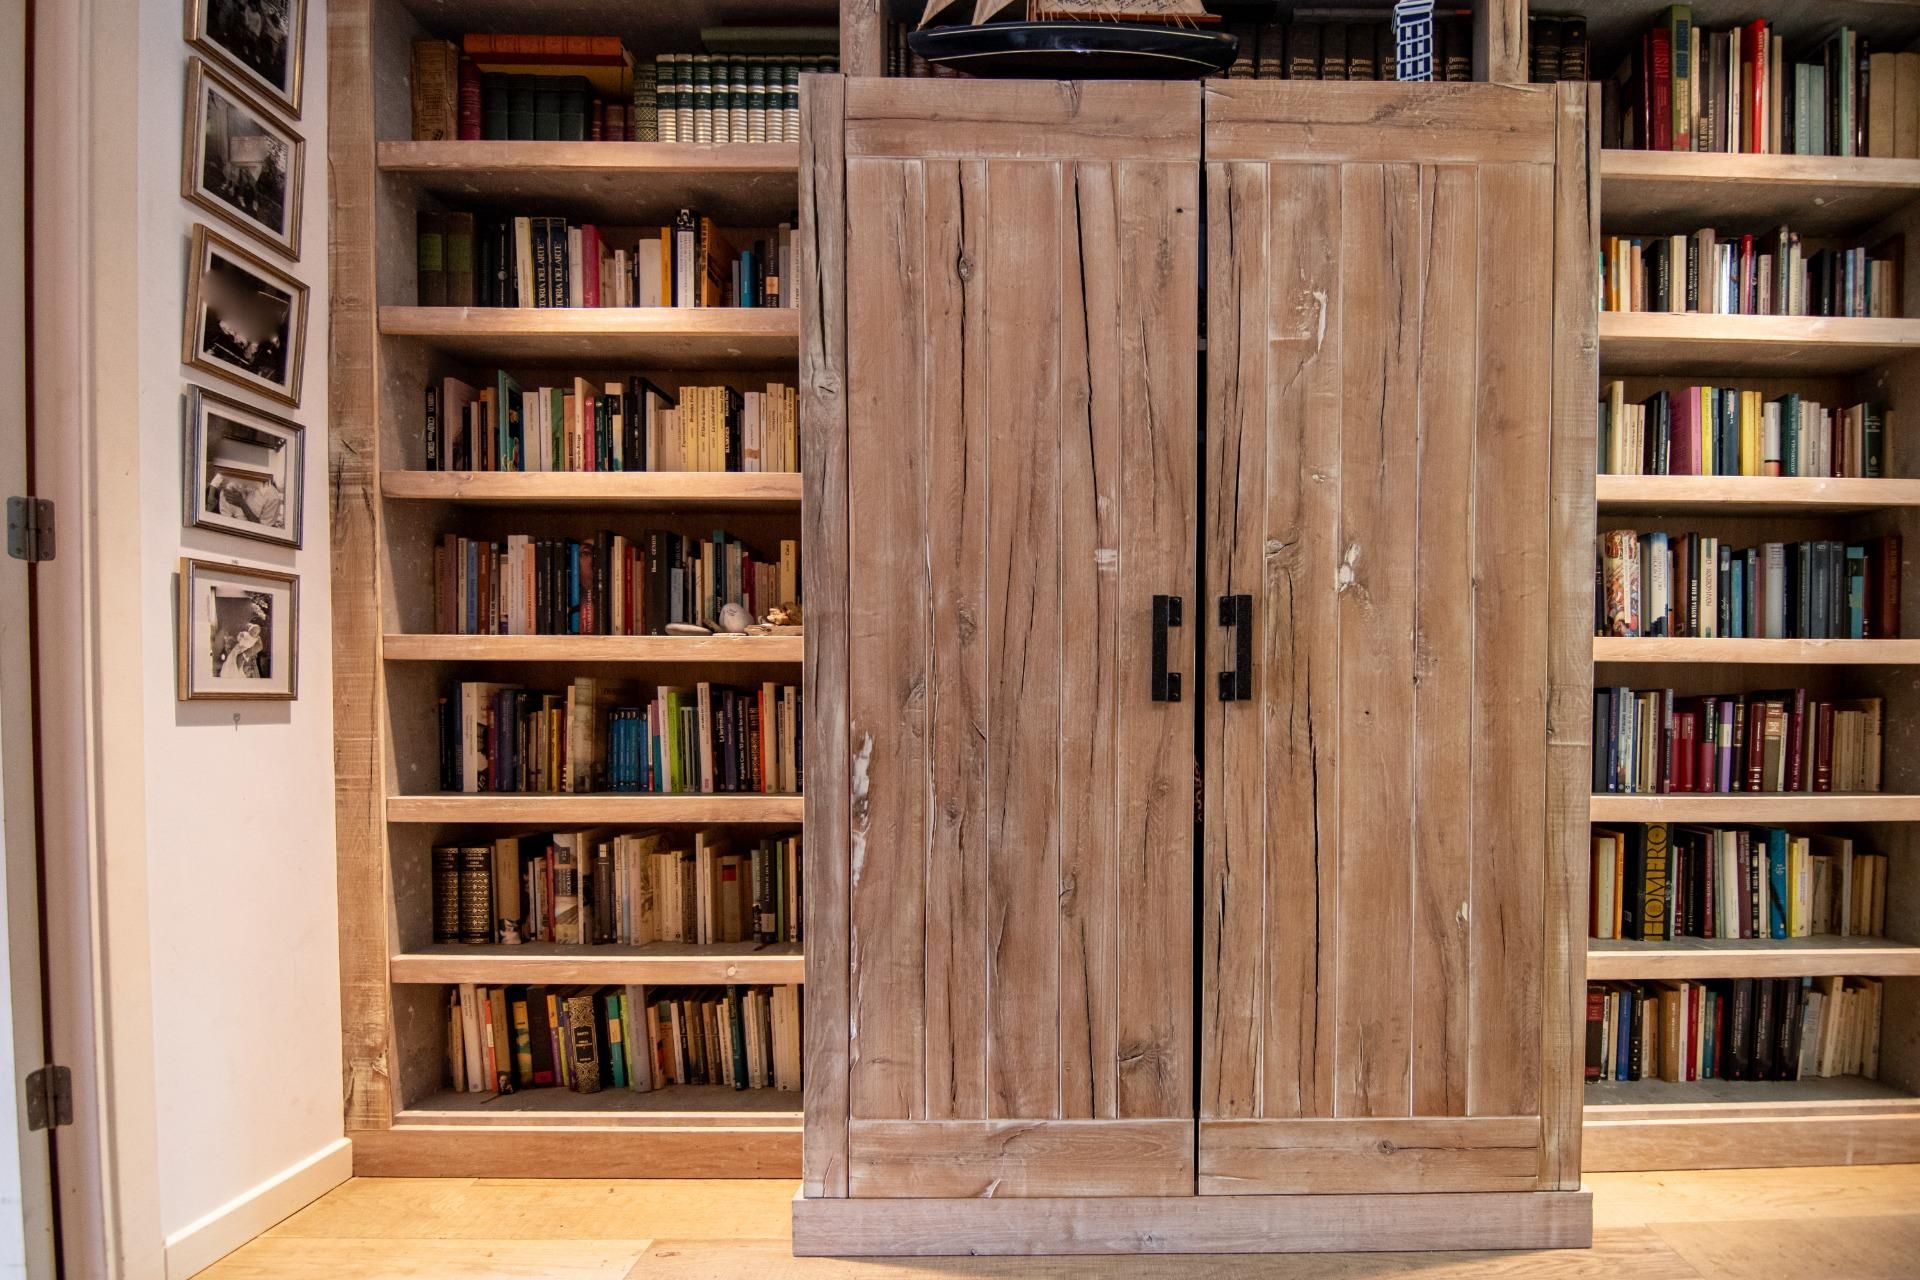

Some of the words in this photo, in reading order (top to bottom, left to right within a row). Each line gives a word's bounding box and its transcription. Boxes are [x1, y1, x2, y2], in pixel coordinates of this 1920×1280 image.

[536, 243, 546, 265] ARTE
[553, 243, 563, 265] ARTE
[537, 266, 546, 281] DEL
[554, 266, 563, 281] DEL
[1644, 824, 1667, 937] HOMERO
